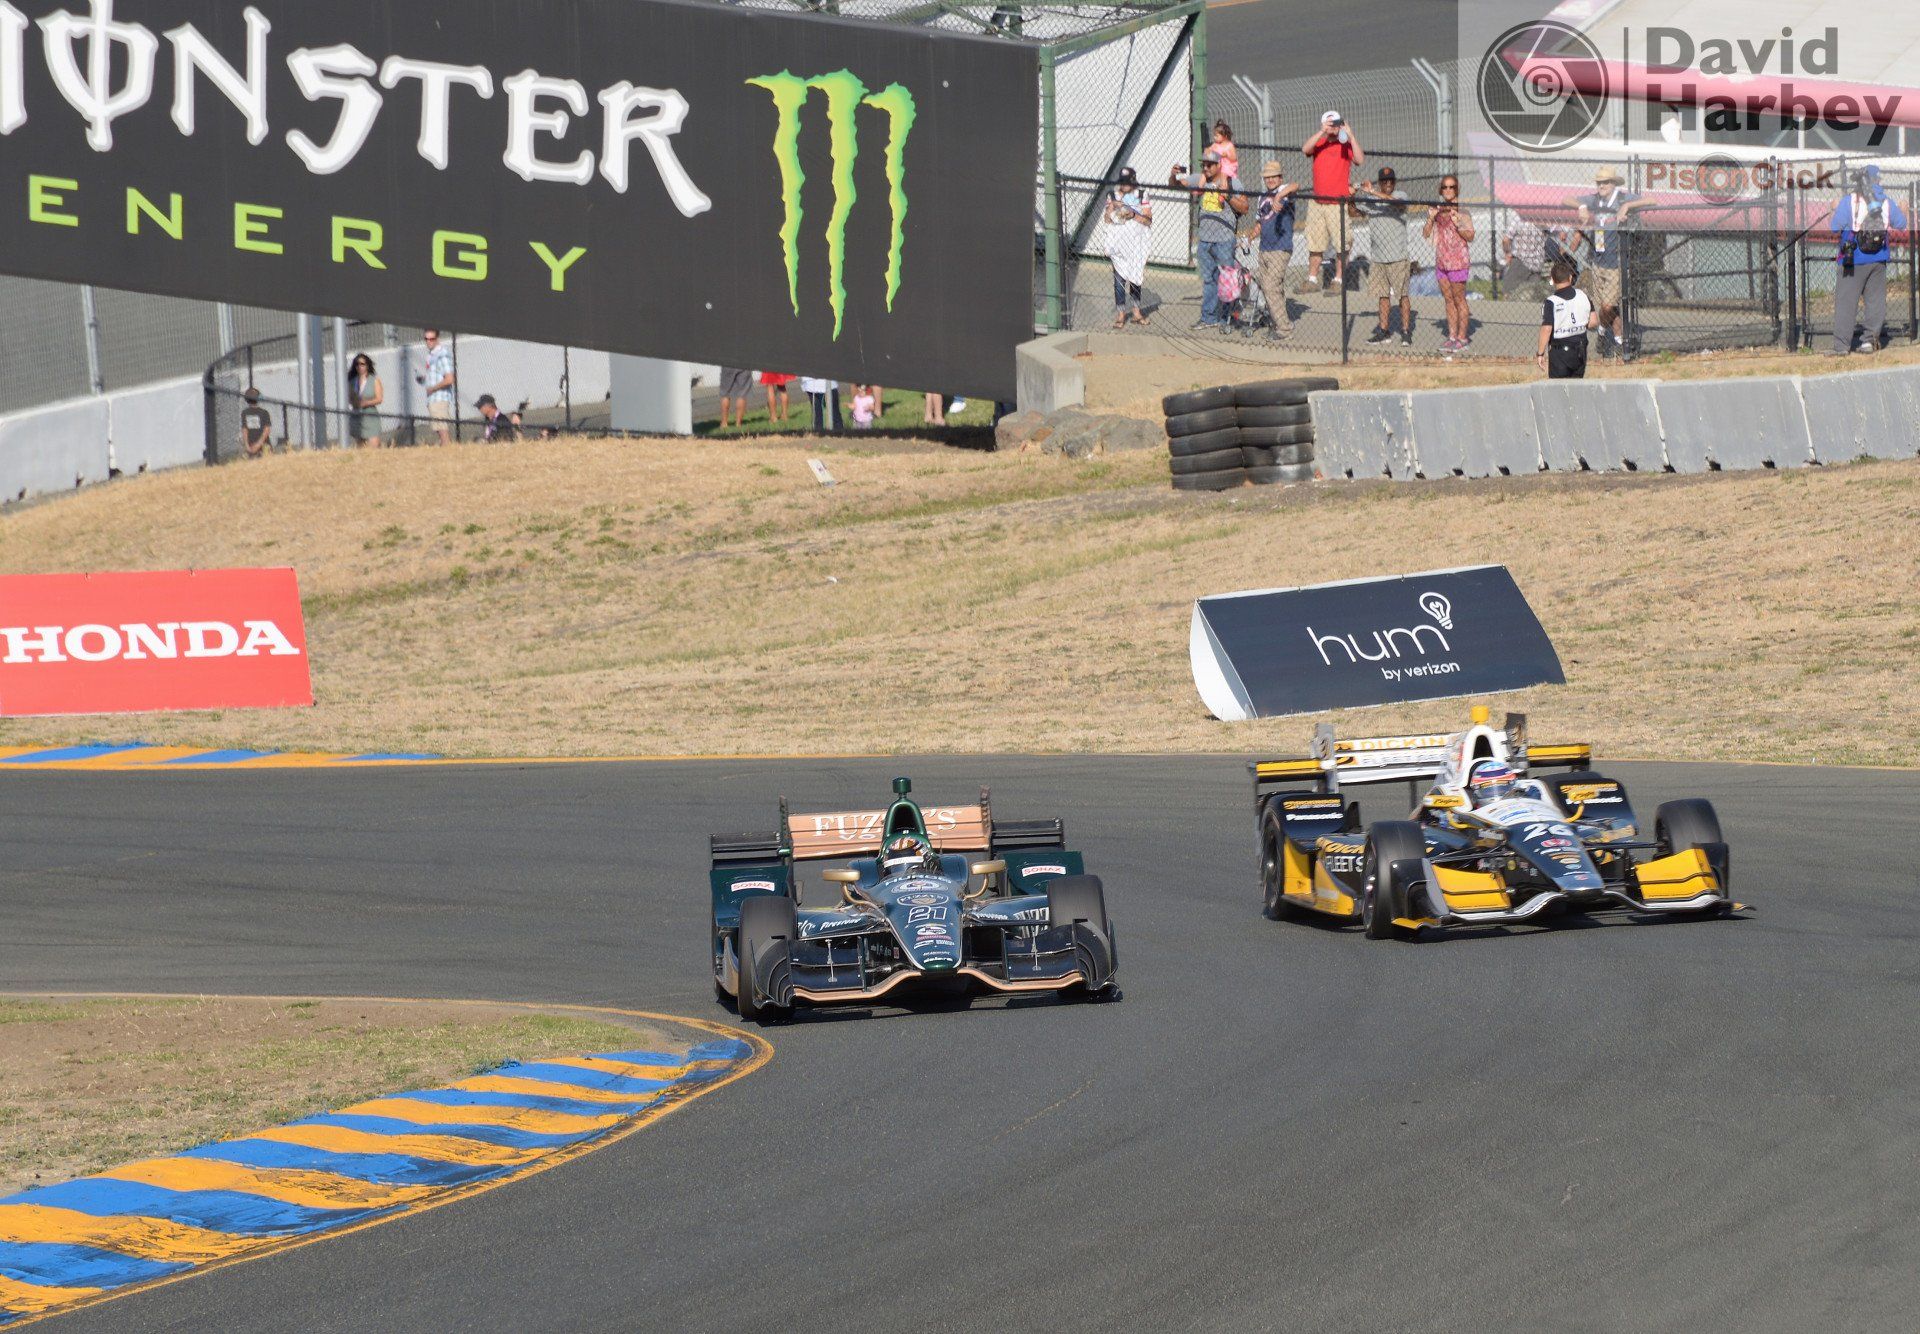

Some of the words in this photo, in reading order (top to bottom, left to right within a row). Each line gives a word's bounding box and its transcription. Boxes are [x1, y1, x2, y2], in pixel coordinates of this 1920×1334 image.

[28, 174, 588, 292] ENERGY
[0, 620, 300, 663] HONDA
[1306, 624, 1450, 666] hum
[1381, 667, 1402, 681] by
[1404, 661, 1461, 678] verizon
[1522, 823, 1575, 843] 26
[1023, 867, 1064, 875] SONAX
[732, 882, 773, 892] SONAX
[907, 906, 947, 923] 21
